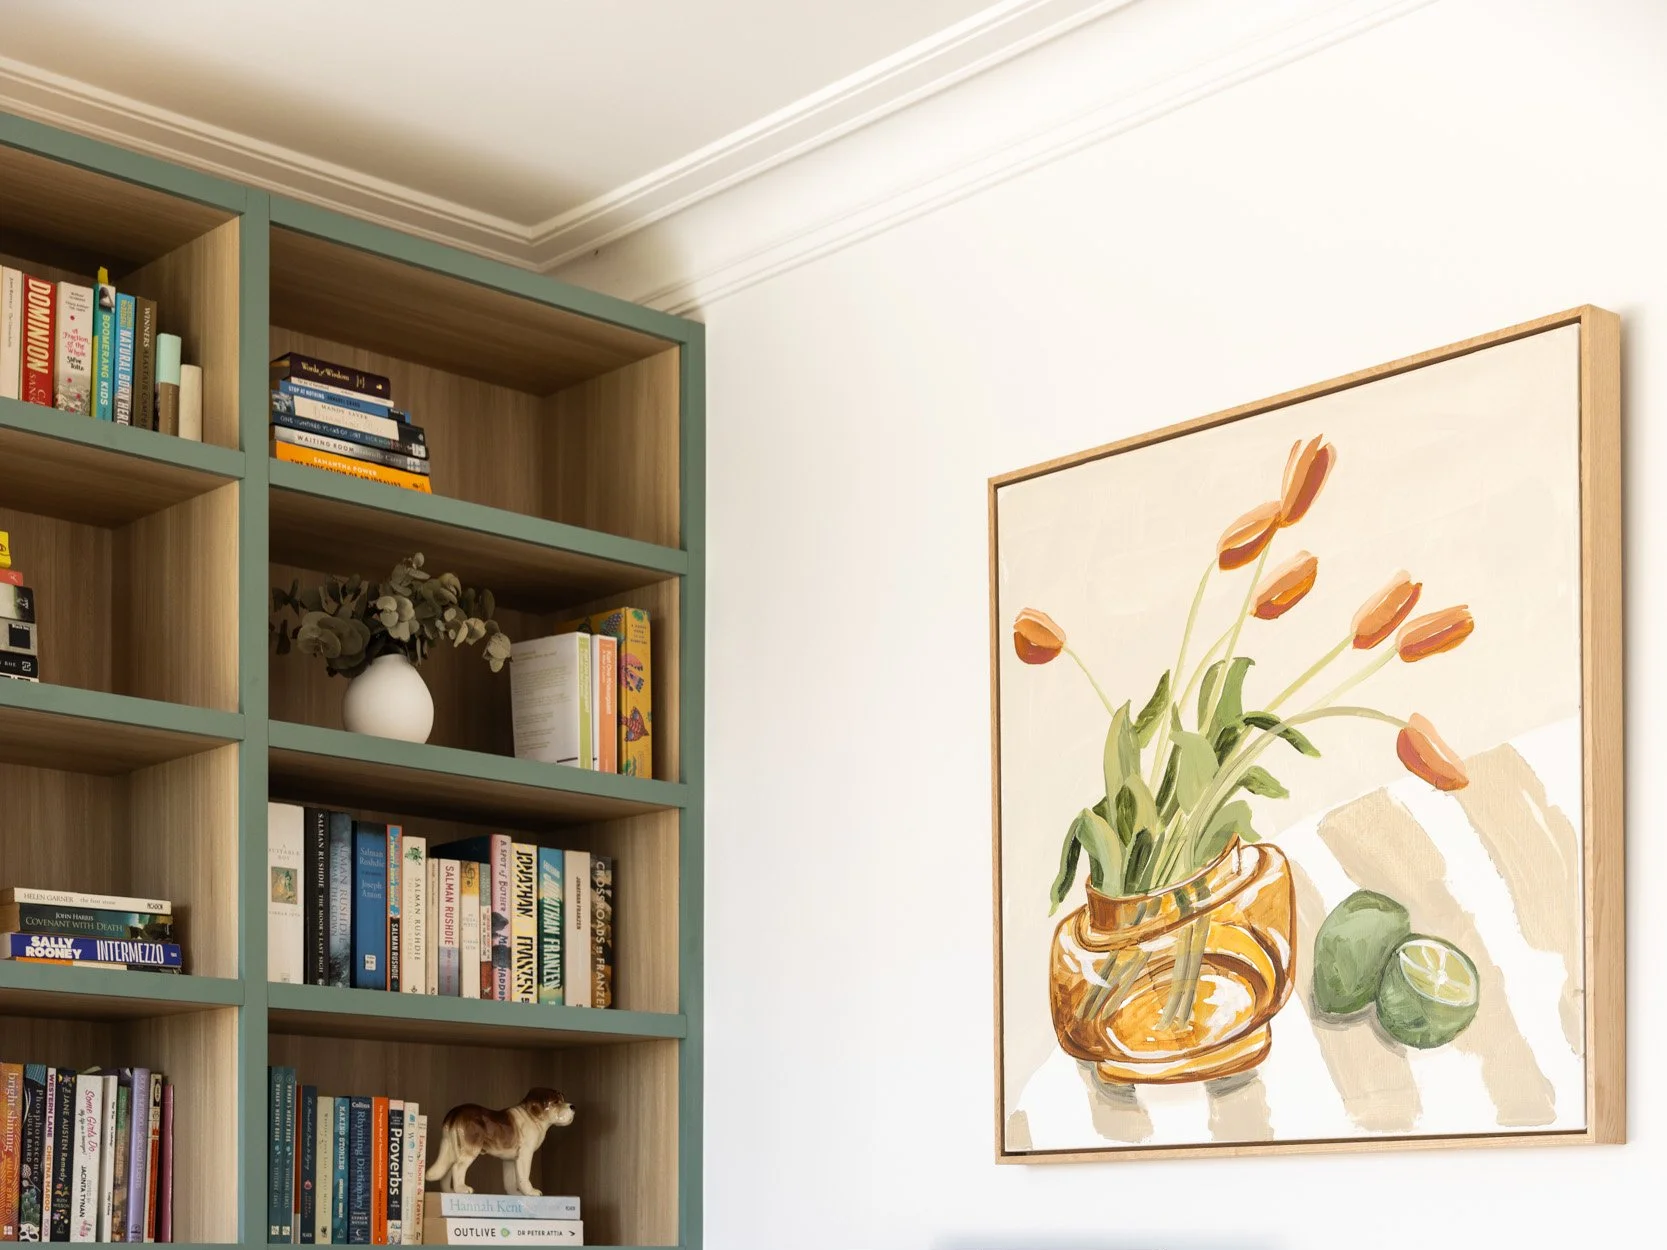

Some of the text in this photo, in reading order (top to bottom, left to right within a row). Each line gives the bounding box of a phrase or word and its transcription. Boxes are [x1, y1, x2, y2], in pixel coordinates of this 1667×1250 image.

[27, 279, 51, 374] DOMINION
[100, 314, 110, 405] BOOMERANG KIDS
[118, 330, 132, 371] NATURAL
[301, 361, 319, 375] Words
[325, 368, 350, 381] Wisdom
[117, 373, 130, 399] BORN
[306, 389, 324, 400] NOTHING
[297, 434, 354, 452] WAITING ROOM
[314, 457, 377, 476] SAMANTHA POWER
[359, 847, 383, 858] Salman
[359, 858, 385, 868] Rushdie
[361, 880, 382, 891] Joseph
[361, 889, 382, 899] Anton
[445, 865, 454, 903] SALMAN
[499, 881, 509, 912] BOTHER
[23, 892, 45, 901] HELEN
[46, 894, 74, 903] GARNER
[596, 861, 605, 943] CROSSROADS
[26, 917, 123, 932] COVENANT WITH DEATH
[55, 912, 94, 921] JOHN HARRIS
[339, 889, 348, 943] RUSHDIE
[445, 906, 454, 945] RUSHDIE
[516, 851, 533, 995] JONATHAN FRANZEN
[31, 936, 74, 948] SALLY
[543, 873, 561, 990] JONATHAN FRANZEN
[25, 946, 82, 959] ROONEY
[96, 940, 164, 964] INTERMEZZO
[6, 1072, 18, 1107] bright
[84, 1089, 95, 1114] Some
[4, 1110, 17, 1152] shining
[32, 1089, 44, 1182] Phosphorescence
[86, 1116, 96, 1138] Girls
[355, 1111, 365, 1156] Rhyming
[59, 1152, 68, 1182] Remedy
[390, 1128, 402, 1195] Proverbs
[355, 1158, 364, 1209] Dictionary
[5, 1188, 13, 1214] BAIRD
[450, 1199, 493, 1212] Hannah
[497, 1201, 522, 1213] Kent
[454, 1228, 496, 1237] OUTLIVE
